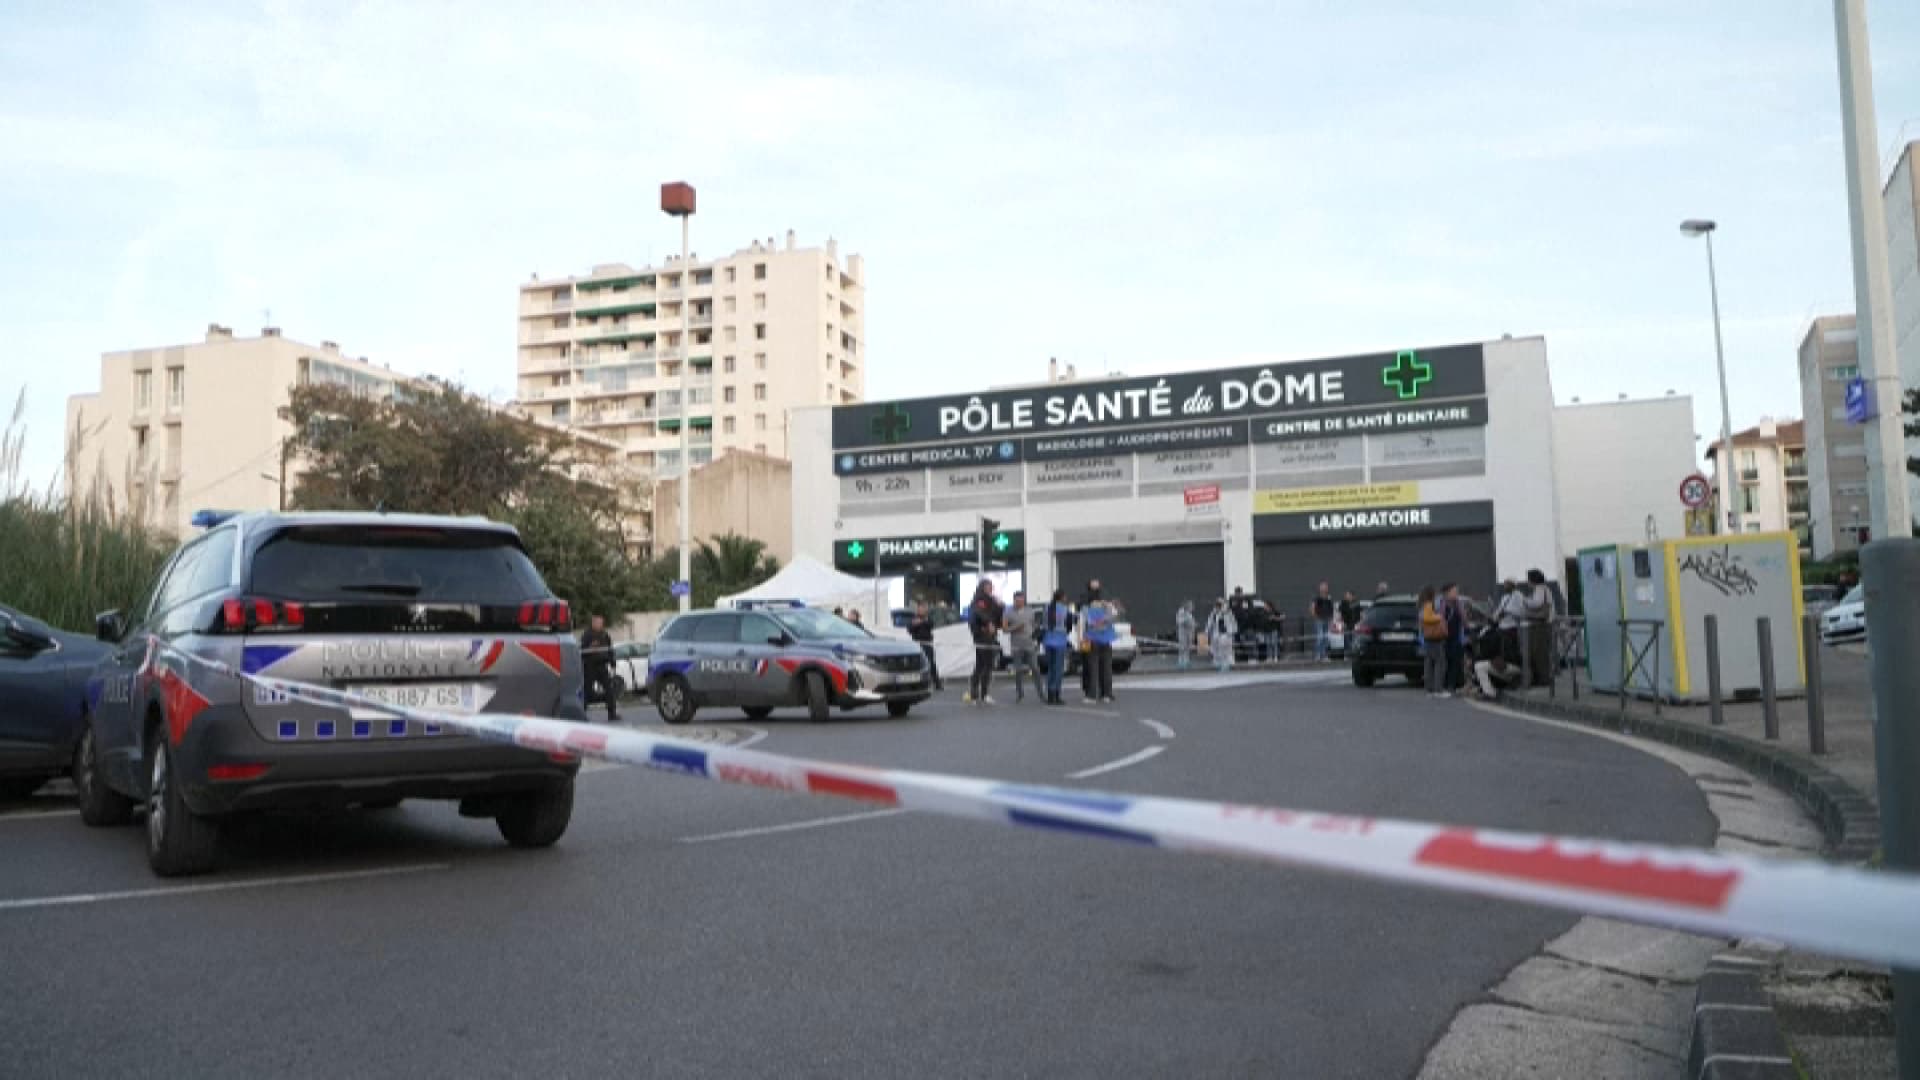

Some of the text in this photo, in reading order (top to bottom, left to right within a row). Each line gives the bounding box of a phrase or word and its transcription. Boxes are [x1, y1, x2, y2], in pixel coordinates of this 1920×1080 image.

[940, 369, 1344, 434] PÔLE SANTÉ du DÔME
[1267, 406, 1470, 436] CENTRE DE SANTÉ DENTAIRE
[858, 453, 908, 468] CENTRE
[1308, 509, 1432, 531] LABORATOIRE
[879, 535, 976, 556] PHARMACIE
[322, 638, 452, 661] POLICE
[322, 662, 456, 679] NATIONALE
[700, 658, 751, 673] POLICE
